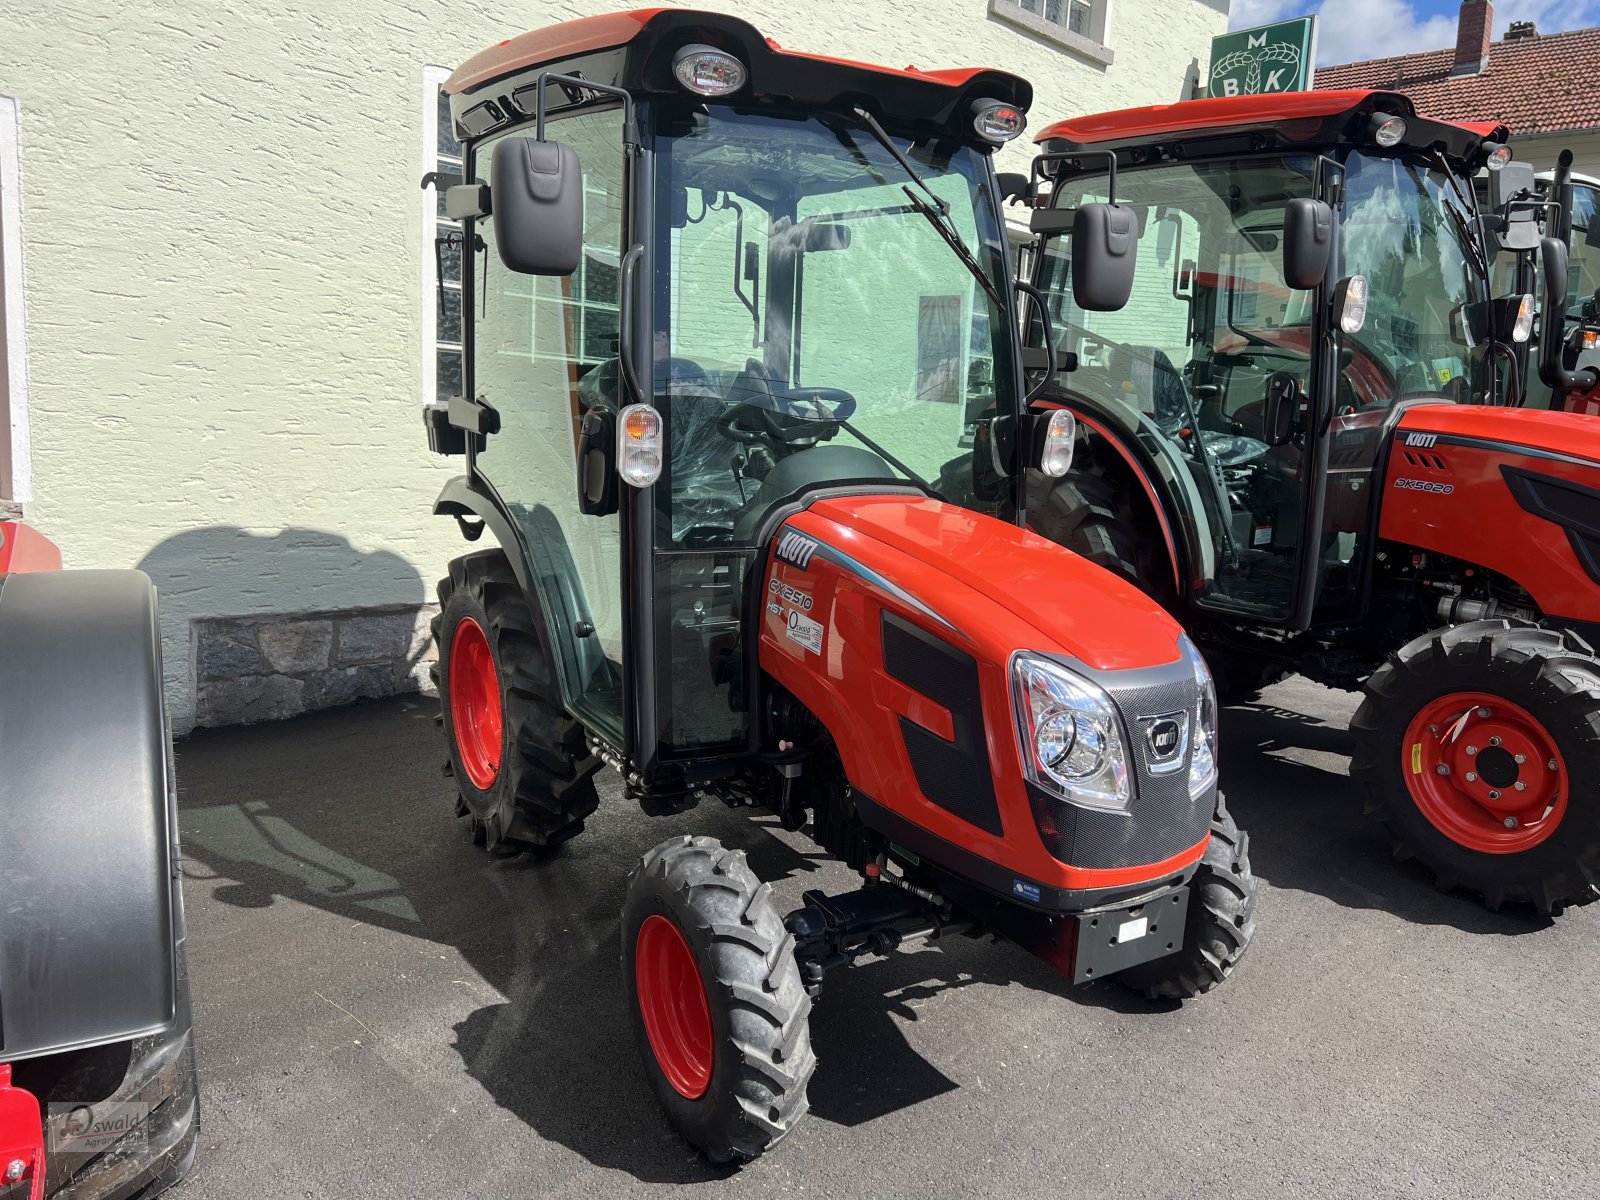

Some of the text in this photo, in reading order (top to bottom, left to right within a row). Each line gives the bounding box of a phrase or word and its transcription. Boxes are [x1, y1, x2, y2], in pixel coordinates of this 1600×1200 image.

[1247, 30, 1268, 49] M
[1223, 68, 1286, 97] B K
[1405, 433, 1437, 448] KIOTI
[1394, 478, 1454, 494] DK5020
[778, 532, 818, 567] KIOTI
[769, 578, 813, 610] CX2510
